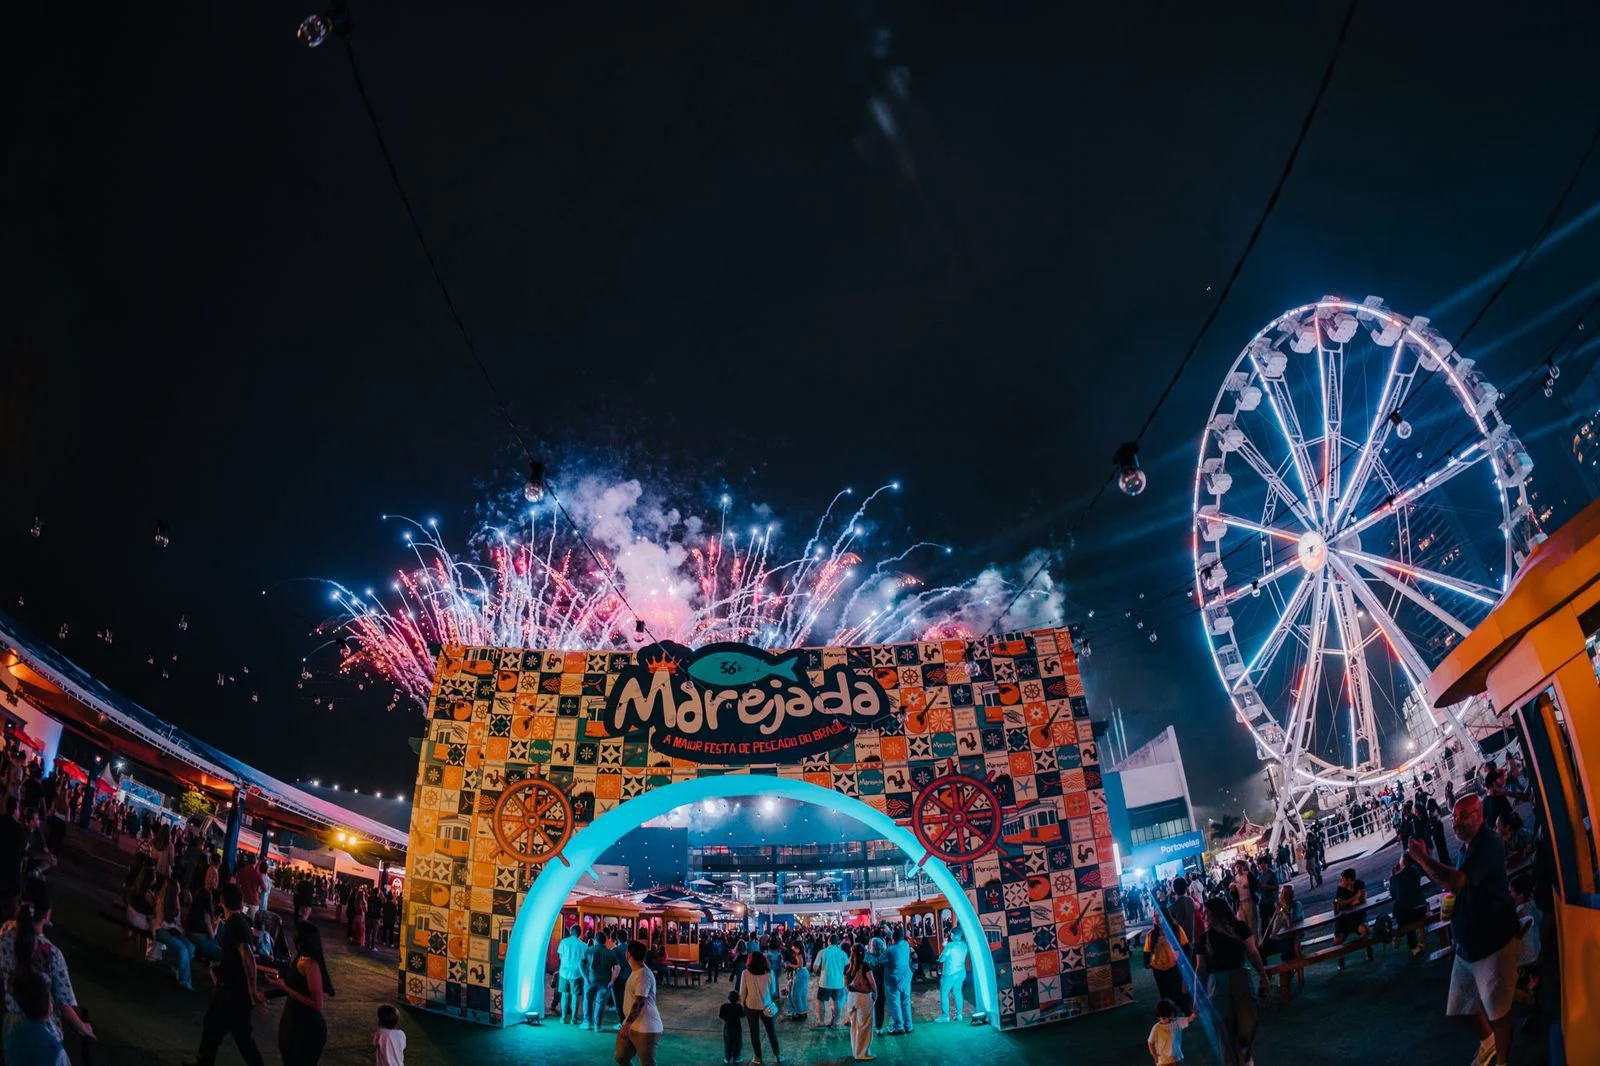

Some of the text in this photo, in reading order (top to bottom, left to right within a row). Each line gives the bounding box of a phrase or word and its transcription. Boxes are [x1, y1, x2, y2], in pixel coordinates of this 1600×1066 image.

[614, 667, 880, 735] Marejada
[662, 734, 671, 744] A
[672, 736, 703, 752] MAIOR
[704, 742, 736, 754] FESTA
[738, 743, 751, 754] DE
[752, 737, 797, 753] PESCADO
[798, 733, 812, 744] DO
[812, 720, 847, 740] BRASIL
